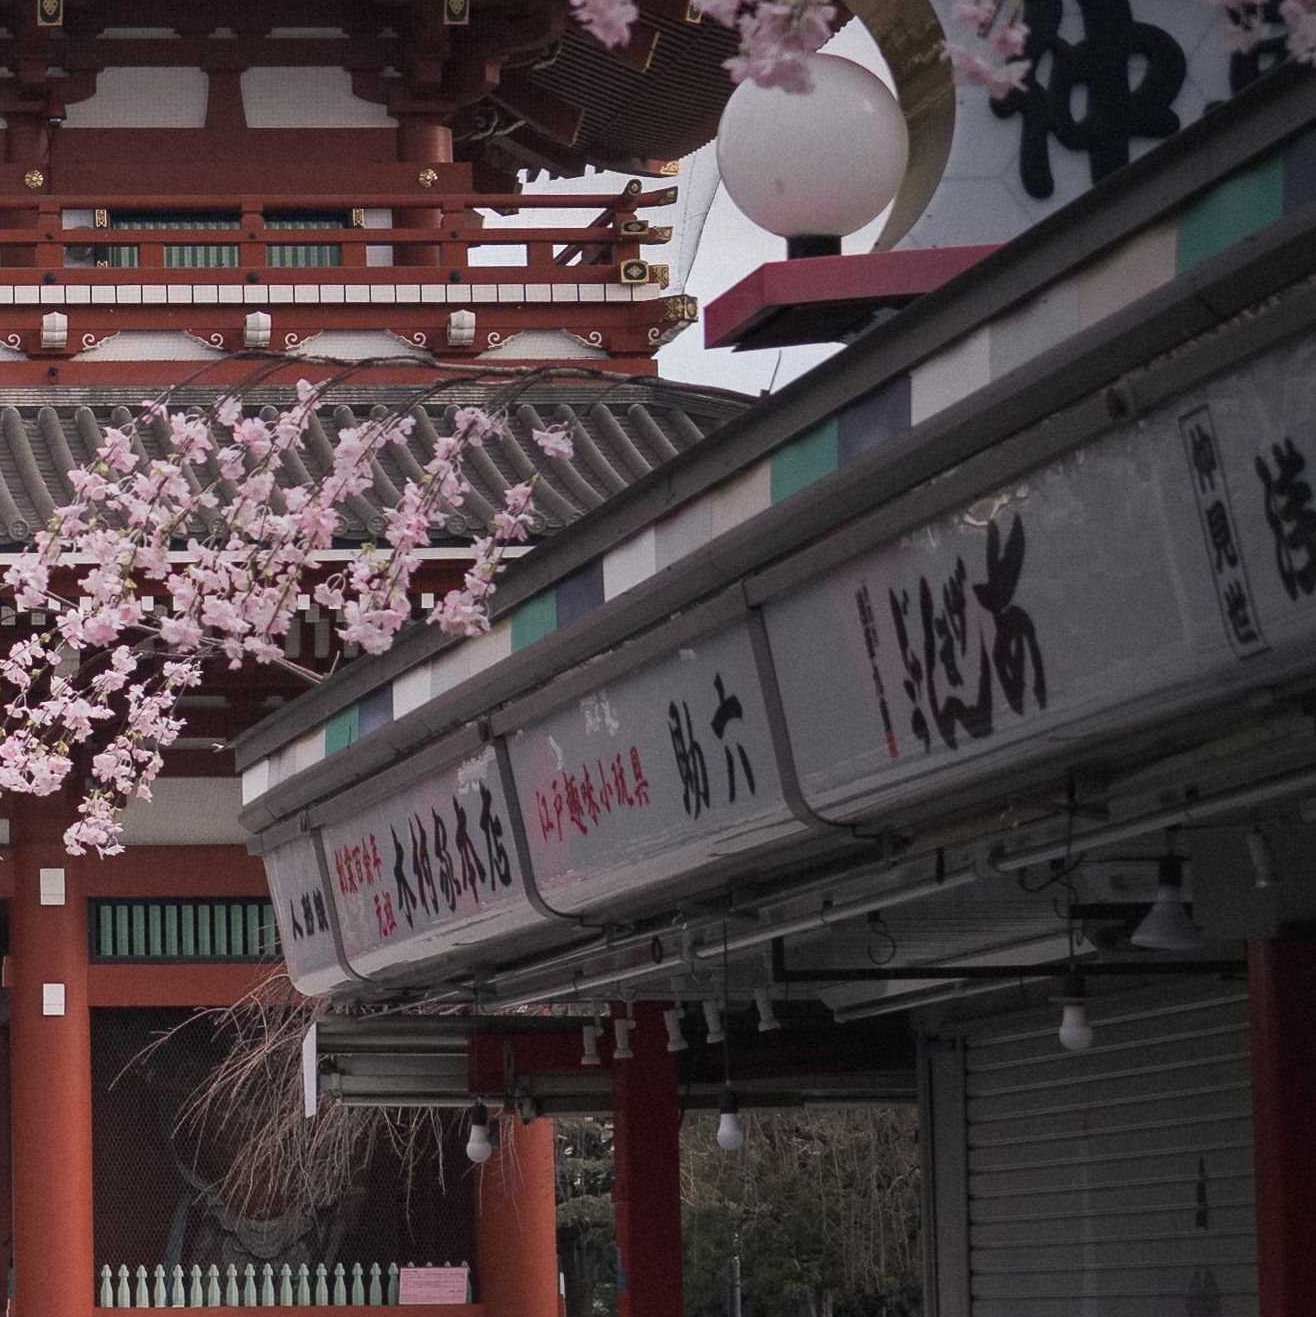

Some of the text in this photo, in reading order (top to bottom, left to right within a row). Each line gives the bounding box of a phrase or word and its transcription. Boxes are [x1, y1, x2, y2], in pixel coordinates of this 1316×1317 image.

[669, 671, 756, 820] 助六
[390, 781, 512, 929] 木村家本店
